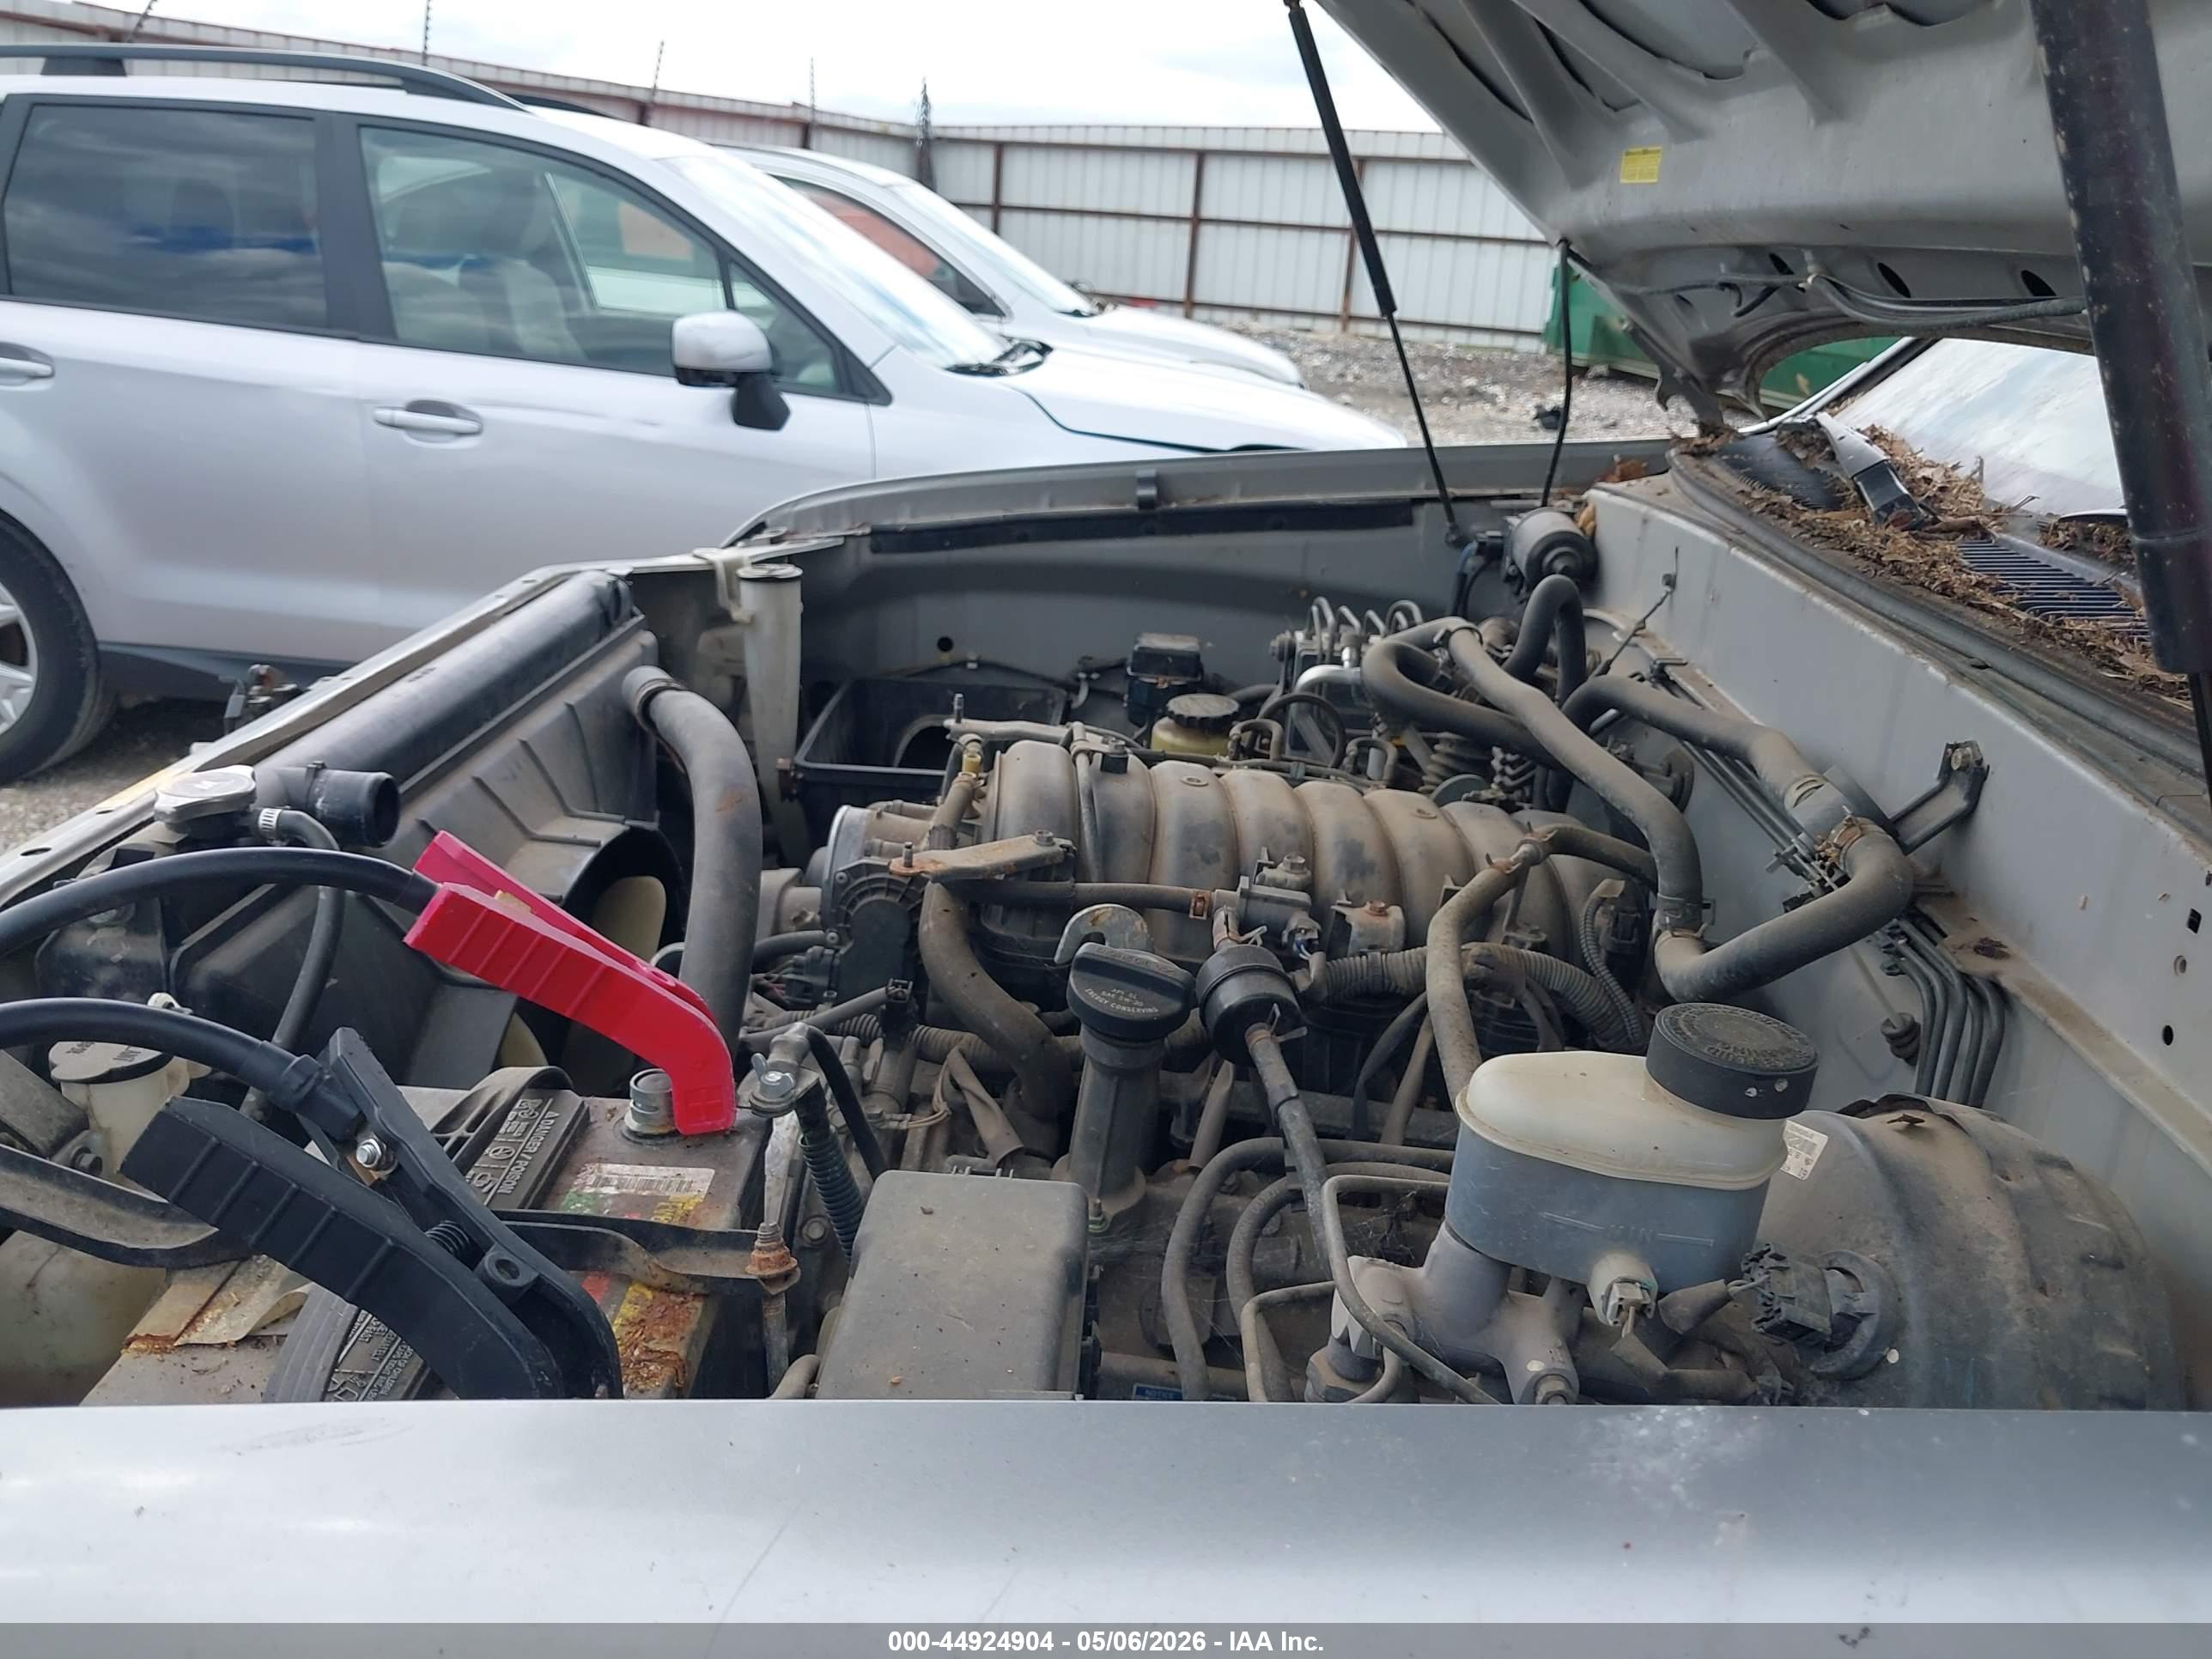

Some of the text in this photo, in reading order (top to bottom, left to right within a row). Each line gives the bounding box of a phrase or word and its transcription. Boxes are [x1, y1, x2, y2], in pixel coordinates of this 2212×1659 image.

[1085, 988, 1159, 1014] ENERGY CONSERVING
[522, 1119, 555, 1154] DANGER
[497, 1159, 530, 1194] POISON
